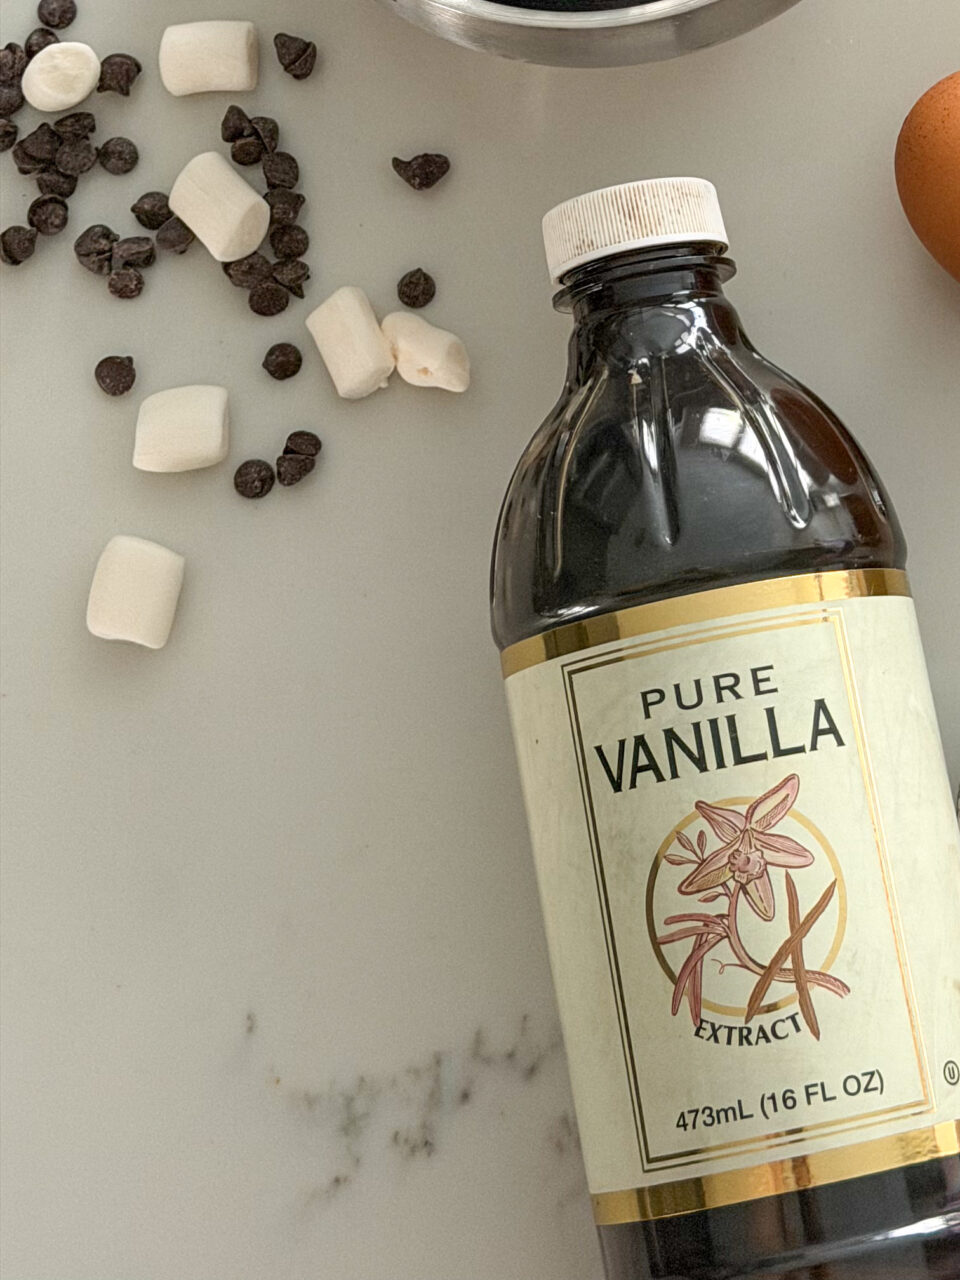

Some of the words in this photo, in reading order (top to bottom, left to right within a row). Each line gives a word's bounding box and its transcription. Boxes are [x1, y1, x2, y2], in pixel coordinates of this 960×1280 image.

[640, 664, 779, 719] PURE
[593, 698, 846, 793] VANILLA
[694, 1012, 803, 1047] EXTRACT
[676, 1098, 754, 1132] 473mL
[760, 1088, 797, 1119] (16
[805, 1082, 837, 1106] FL
[843, 1069, 885, 1096] OZ)
